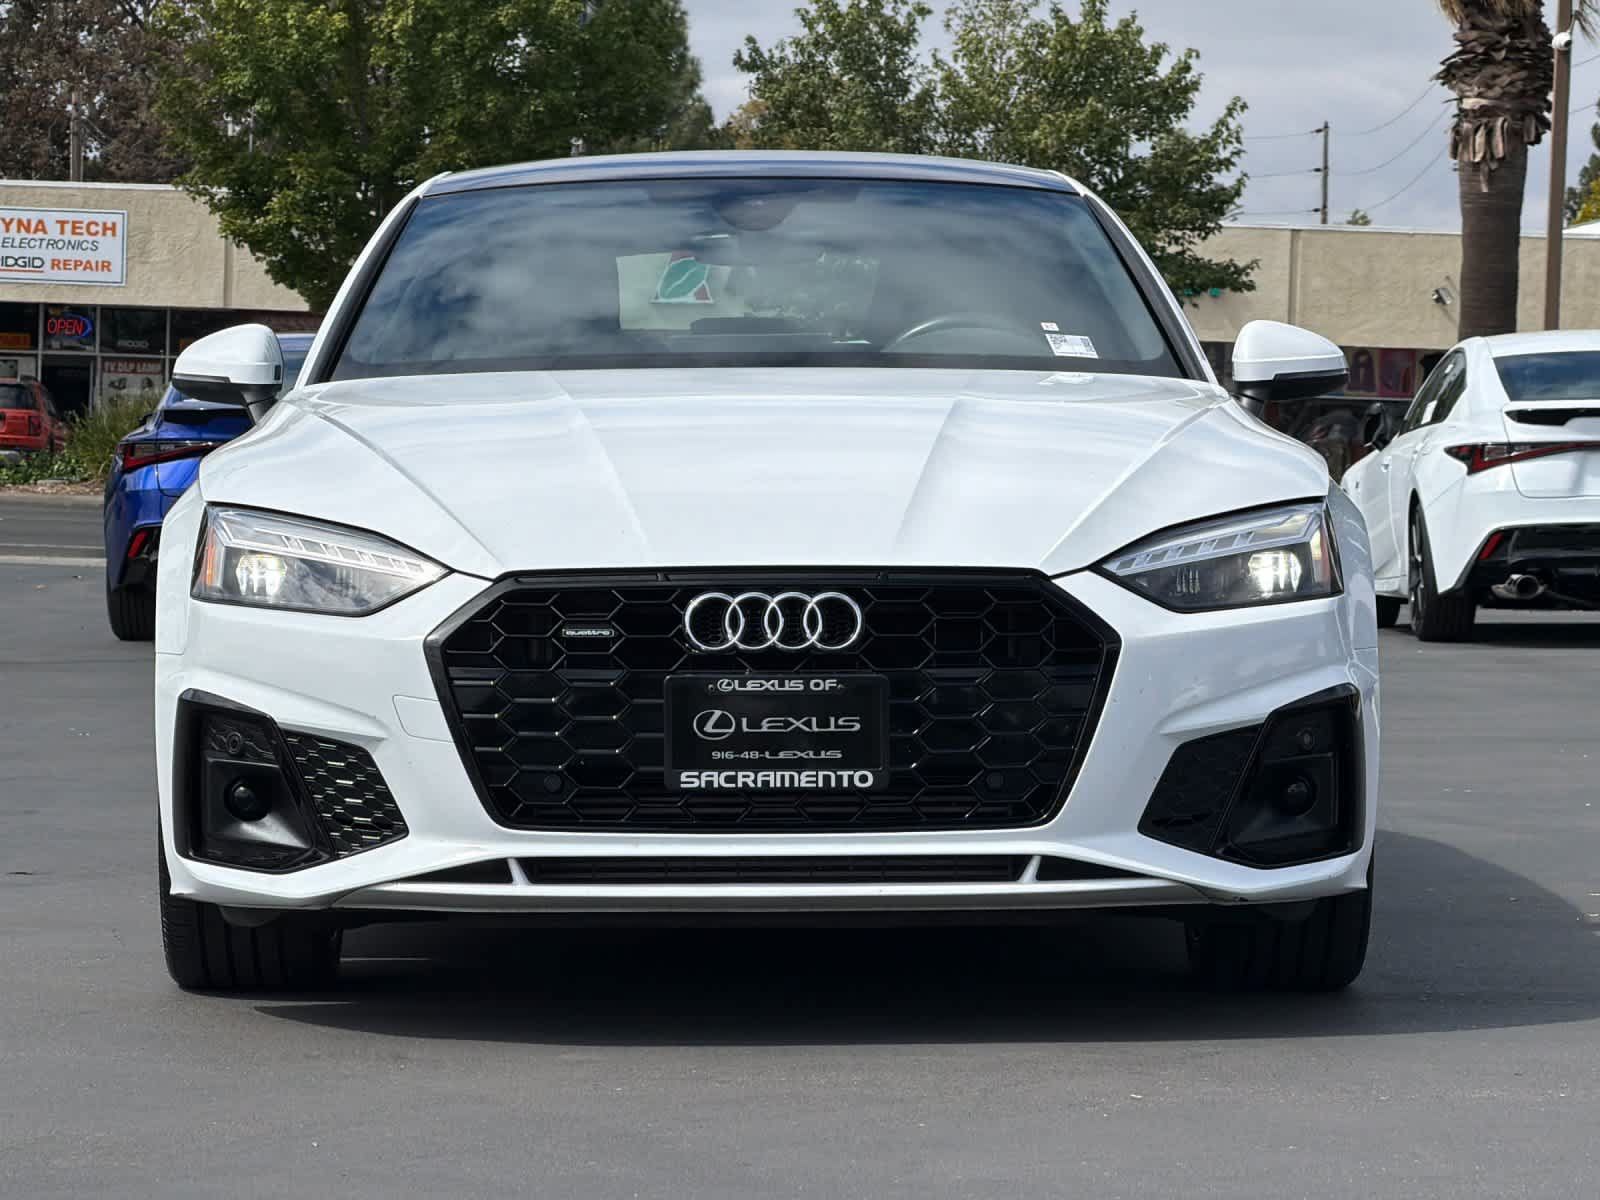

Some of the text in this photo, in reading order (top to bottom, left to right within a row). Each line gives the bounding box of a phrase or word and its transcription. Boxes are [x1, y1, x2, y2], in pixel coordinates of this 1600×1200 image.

[56, 219, 117, 237] TECH
[1, 237, 99, 251] ELECTRONICS
[50, 258, 112, 272] REPAIR
[47, 318, 83, 337] OPEN
[734, 679, 837, 691] LEXUS OF
[741, 716, 861, 733] LEXUS
[711, 750, 843, 760] 916-48-LEXUS
[680, 771, 874, 788] SACRAMENTO
